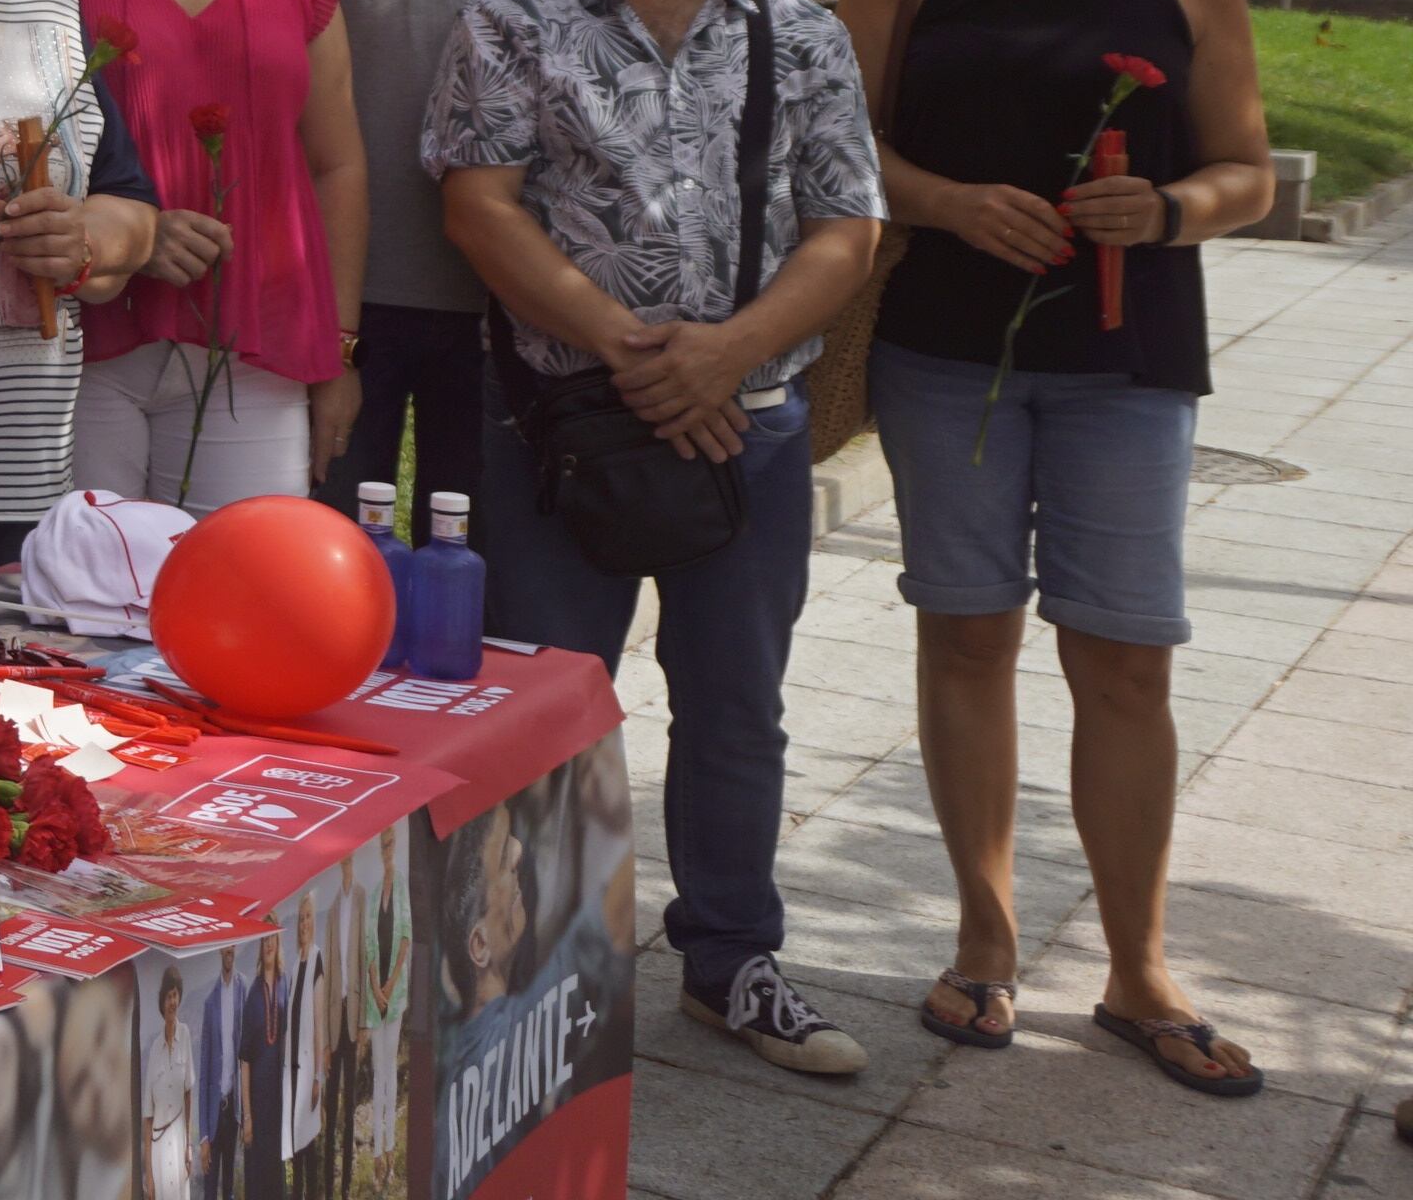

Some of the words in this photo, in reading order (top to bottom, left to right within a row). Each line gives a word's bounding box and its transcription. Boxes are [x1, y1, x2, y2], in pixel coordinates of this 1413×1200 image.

[364, 678, 479, 712] VOTA
[186, 788, 268, 823] PSOE
[130, 911, 221, 932] VOTA
[18, 927, 95, 955] VOTA
[446, 972, 580, 1200] ADELANTE
